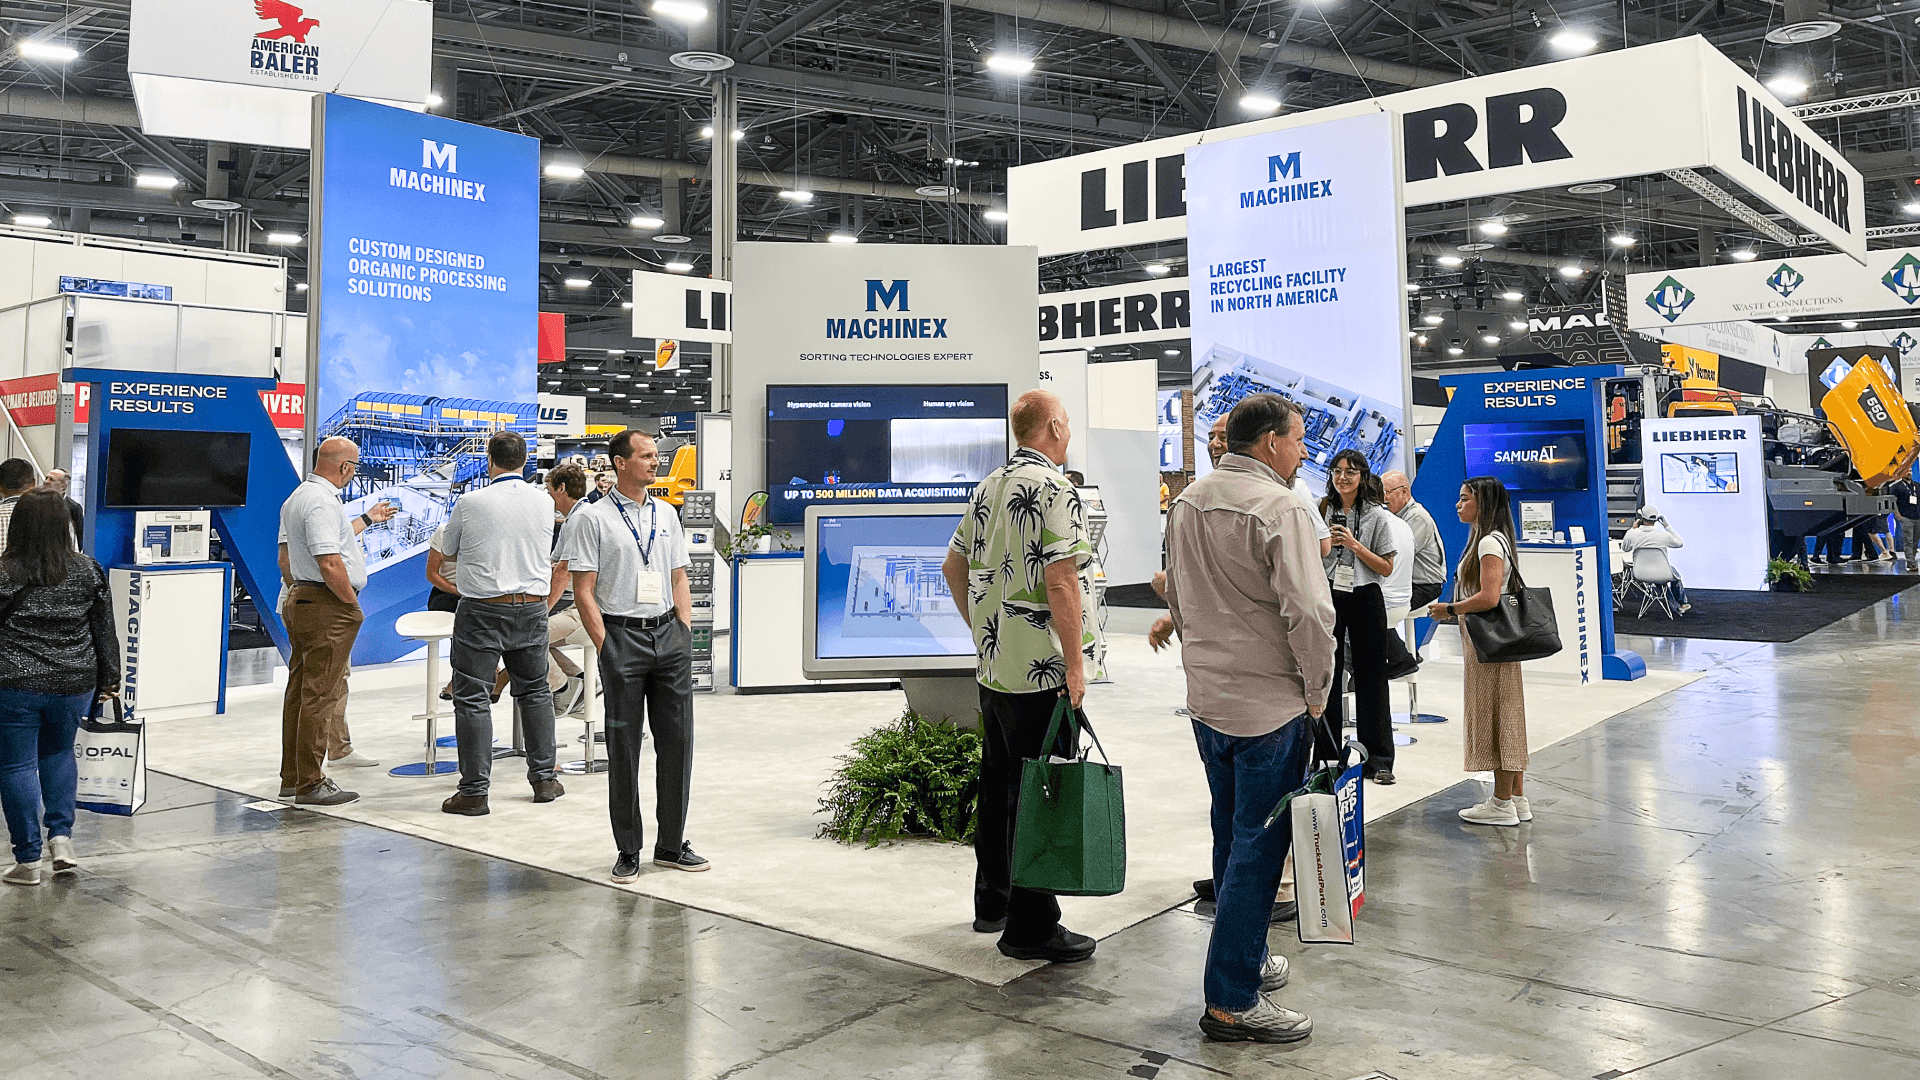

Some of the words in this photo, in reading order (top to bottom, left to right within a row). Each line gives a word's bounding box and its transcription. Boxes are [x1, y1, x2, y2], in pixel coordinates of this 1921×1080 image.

[251, 38, 319, 58] AMERICAN
[250, 50, 319, 76] BALER
[250, 68, 300, 80] ESTABLISHED
[421, 138, 458, 174] M
[1268, 151, 1302, 183] M
[1737, 84, 1851, 234] LIEBHERR
[390, 167, 486, 202] MACHINEX
[1240, 179, 1333, 209] MACHINEX
[348, 237, 411, 261] CUSTOM
[416, 246, 485, 270] DESIGNED
[348, 258, 416, 281] ORGANIC
[420, 266, 507, 292] PROCESSING
[1210, 258, 1267, 278] LARGEST
[348, 278, 432, 302] SOLUTIONS
[1210, 274, 1283, 296] RECYCLING
[1286, 267, 1347, 288] FACILITY
[864, 279, 910, 312] M
[1210, 299, 1224, 314] IN
[1227, 294, 1272, 312] NORTH
[1276, 288, 1339, 308] AMERICA
[1732, 302, 1766, 312] WASTE
[1768, 296, 1844, 309] CONNECTIONS
[826, 318, 948, 339] MACHINEX
[800, 354, 847, 362] SORTING
[849, 354, 931, 362] TECHNOLOGIES
[28, 388, 58, 408] DELIVERED
[110, 382, 228, 398] EXPERIENCE
[1484, 378, 1586, 394] EXPERIENCE
[110, 399, 194, 414] RESULTS
[787, 401, 830, 409] Hyperspectral
[853, 400, 872, 408] vision
[1484, 394, 1556, 409] RESULTS
[1866, 396, 1888, 421] 550
[1652, 429, 1747, 442] LIEBHERR
[784, 490, 800, 500] UP
[800, 490, 814, 499] TO
[815, 490, 834, 499] 500
[836, 488, 876, 498] MILLION
[878, 488, 904, 498] DATA
[904, 487, 966, 498] ACQUISITION
[1575, 550, 1589, 686] MACHINEX
[123, 572, 142, 720] MACHINEX
[86, 747, 134, 758] OPAL
[1311, 808, 1328, 928] www.TrucksAndParts.com
